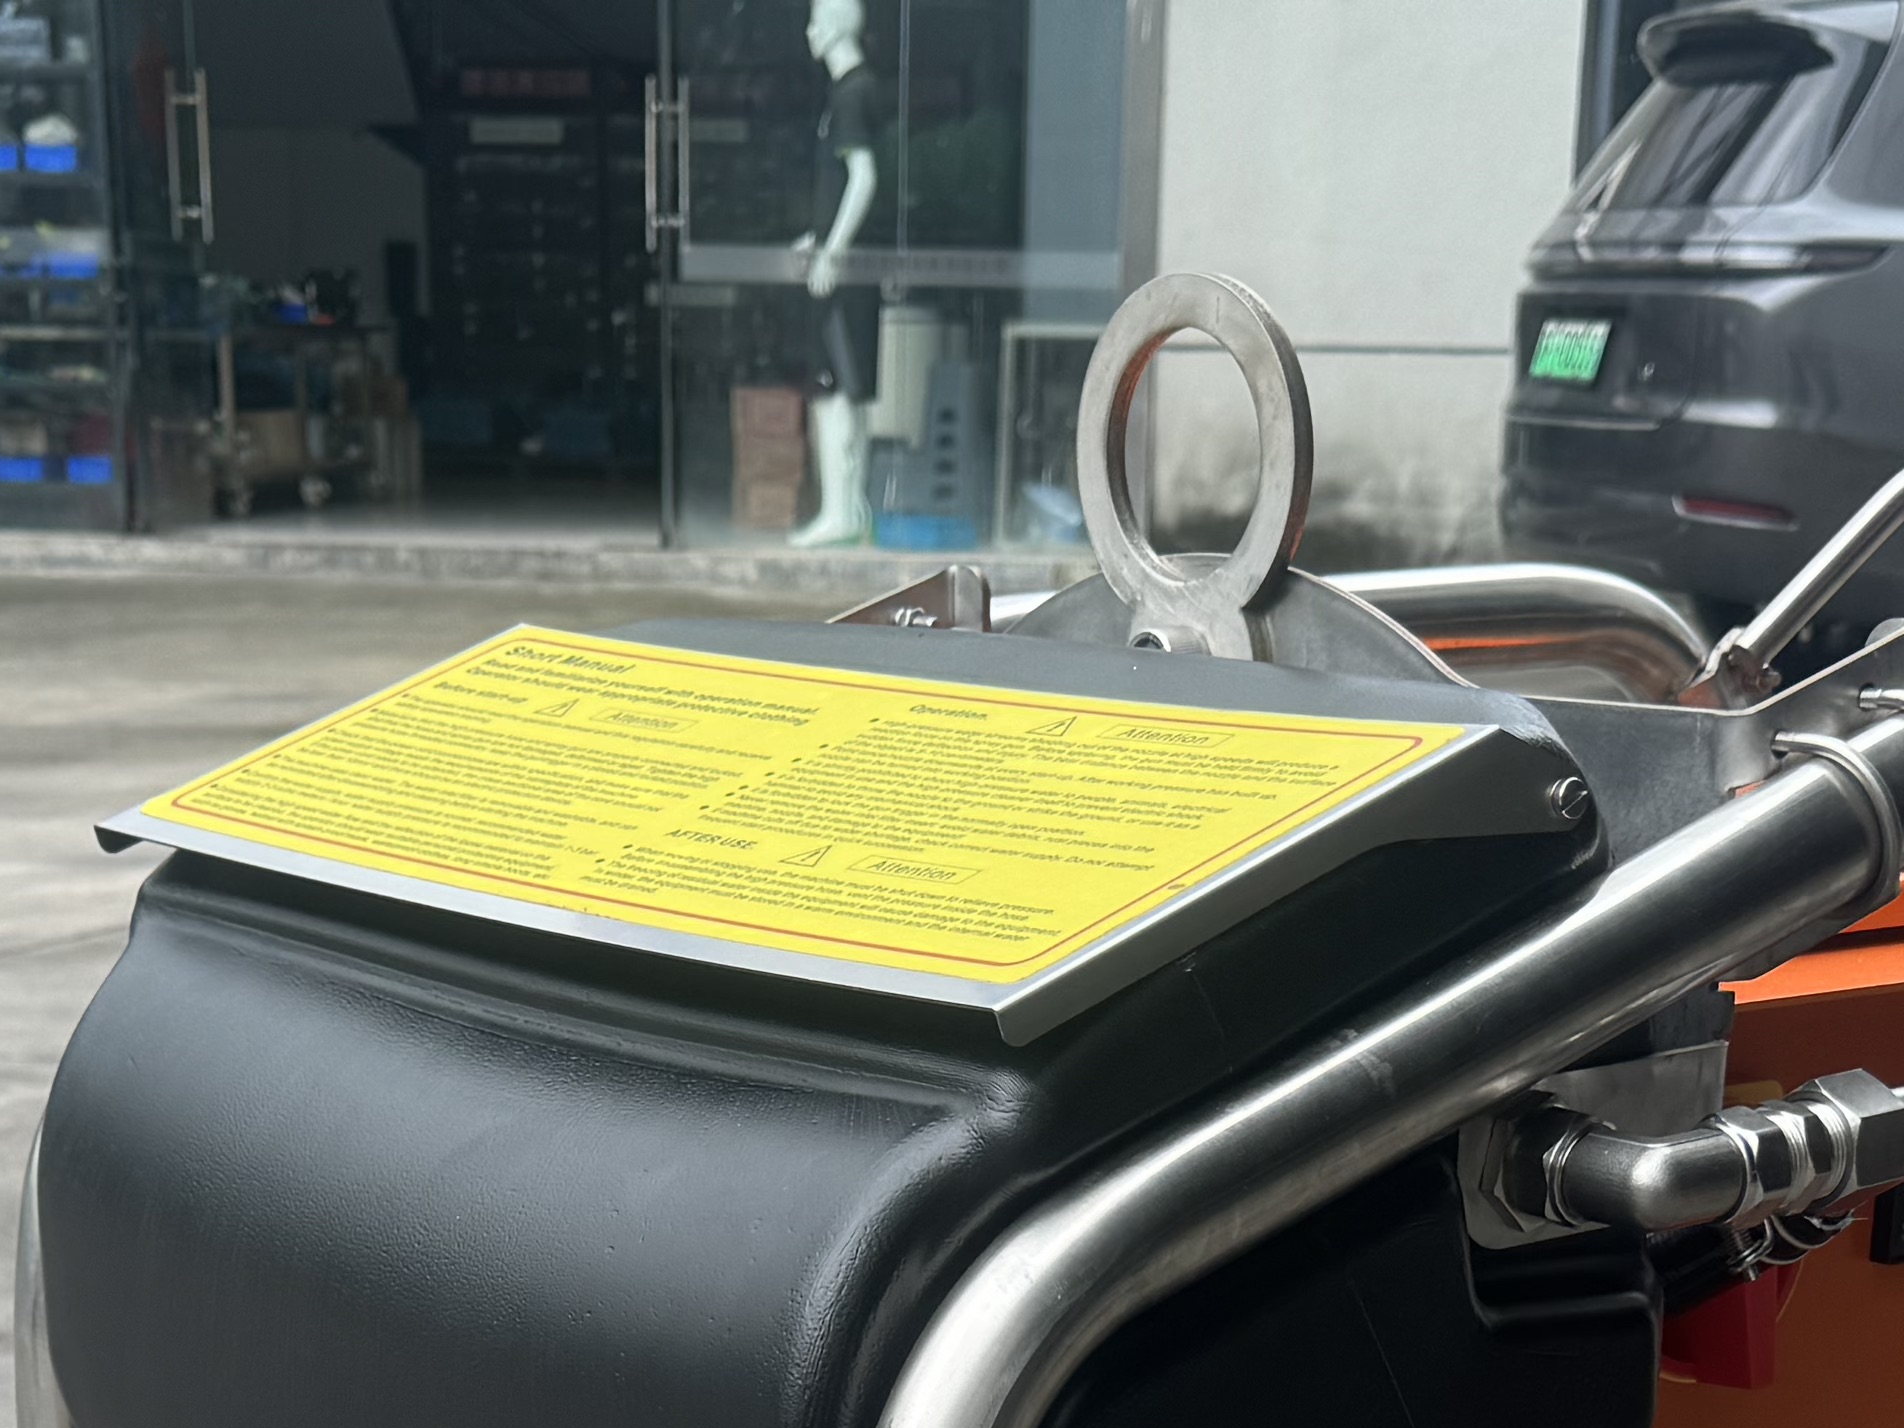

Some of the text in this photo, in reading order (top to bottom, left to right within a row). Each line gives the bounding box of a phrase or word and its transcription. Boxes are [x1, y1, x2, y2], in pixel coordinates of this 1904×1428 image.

[505, 646, 636, 674] Short Manual
[694, 693, 763, 708] operation
[608, 711, 679, 729] Attention
[673, 701, 747, 717] protective
[747, 711, 810, 727] clothing
[1116, 725, 1211, 747] Attention
[664, 827, 724, 847] AFTER
[867, 859, 957, 882] Attention
